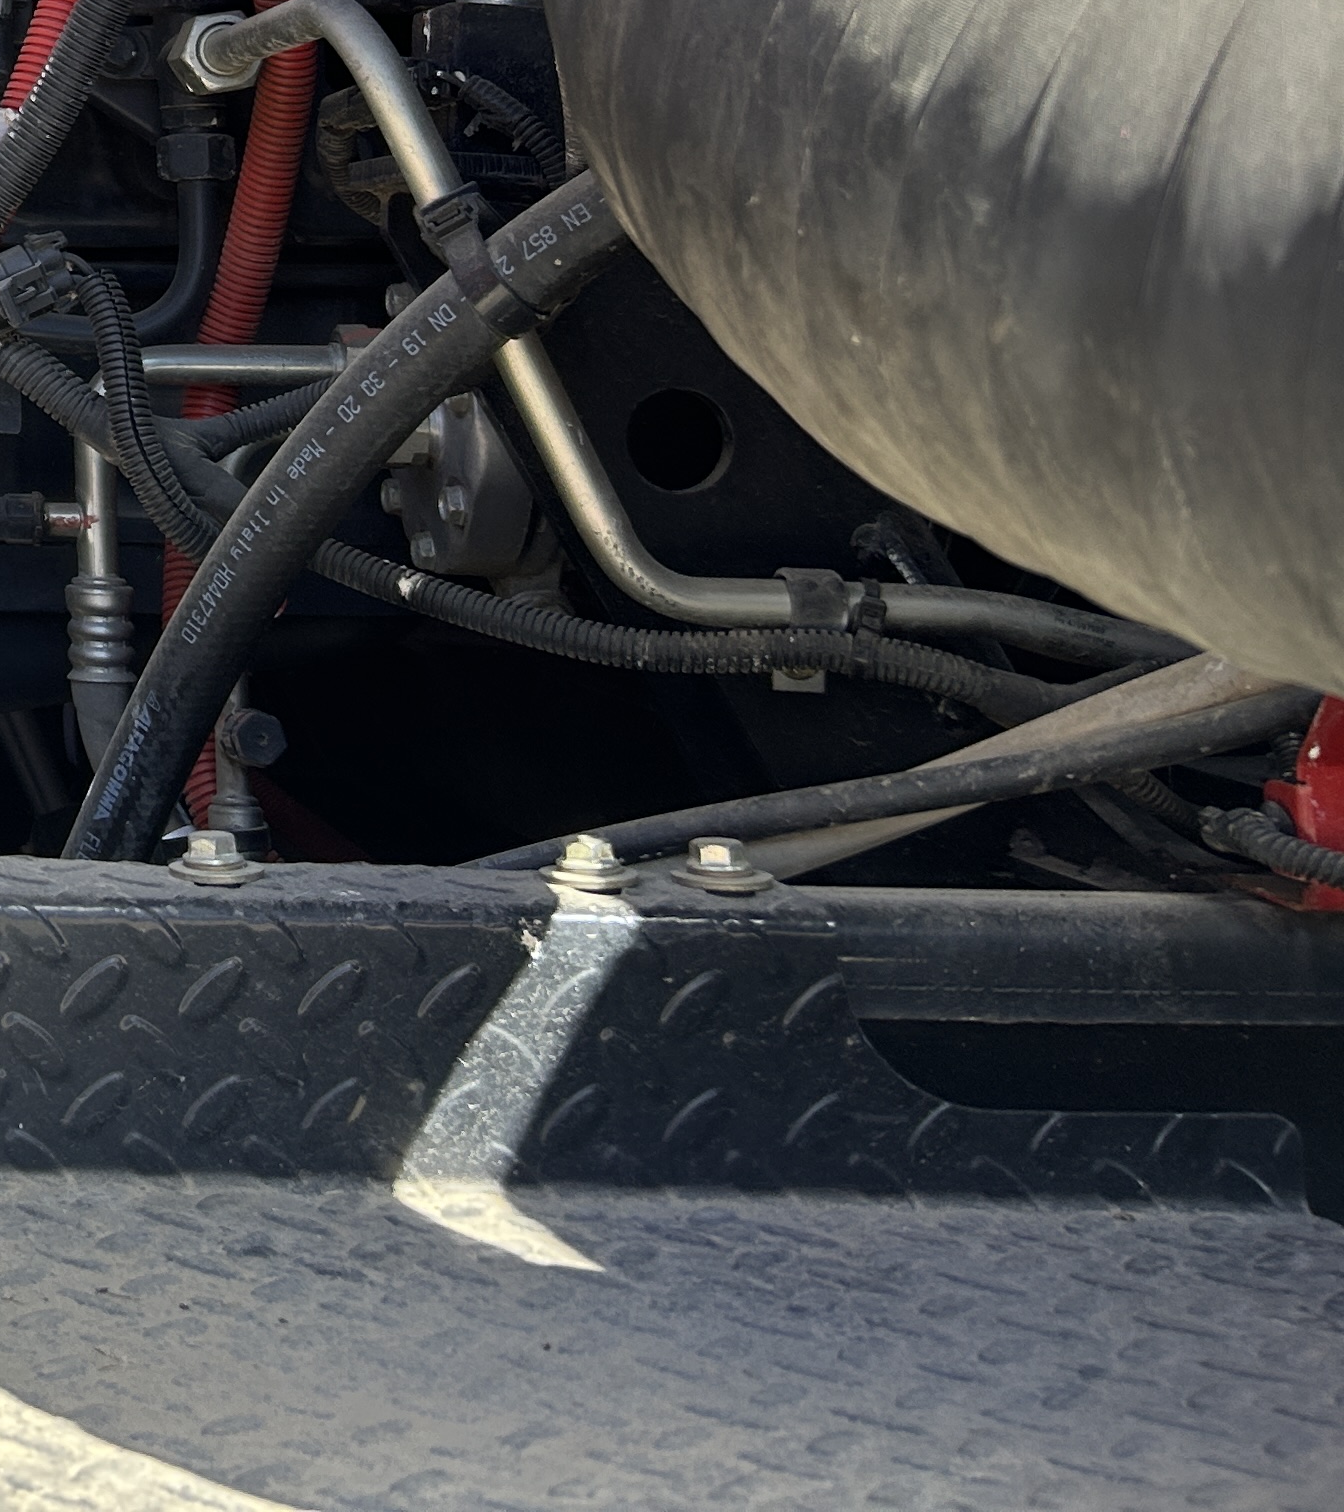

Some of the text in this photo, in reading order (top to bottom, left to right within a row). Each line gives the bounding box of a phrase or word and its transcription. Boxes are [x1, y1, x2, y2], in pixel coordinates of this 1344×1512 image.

[560, 202, 592, 232] EN
[522, 225, 558, 261] 857
[427, 303, 457, 333] DN
[401, 329, 427, 356] 19
[360, 371, 385, 397] 30
[337, 394, 361, 423] 20
[287, 437, 326, 480] Made
[265, 484, 286, 506] in
[230, 509, 270, 561] Italy
[93, 703, 152, 820] ALFAGOMMA
